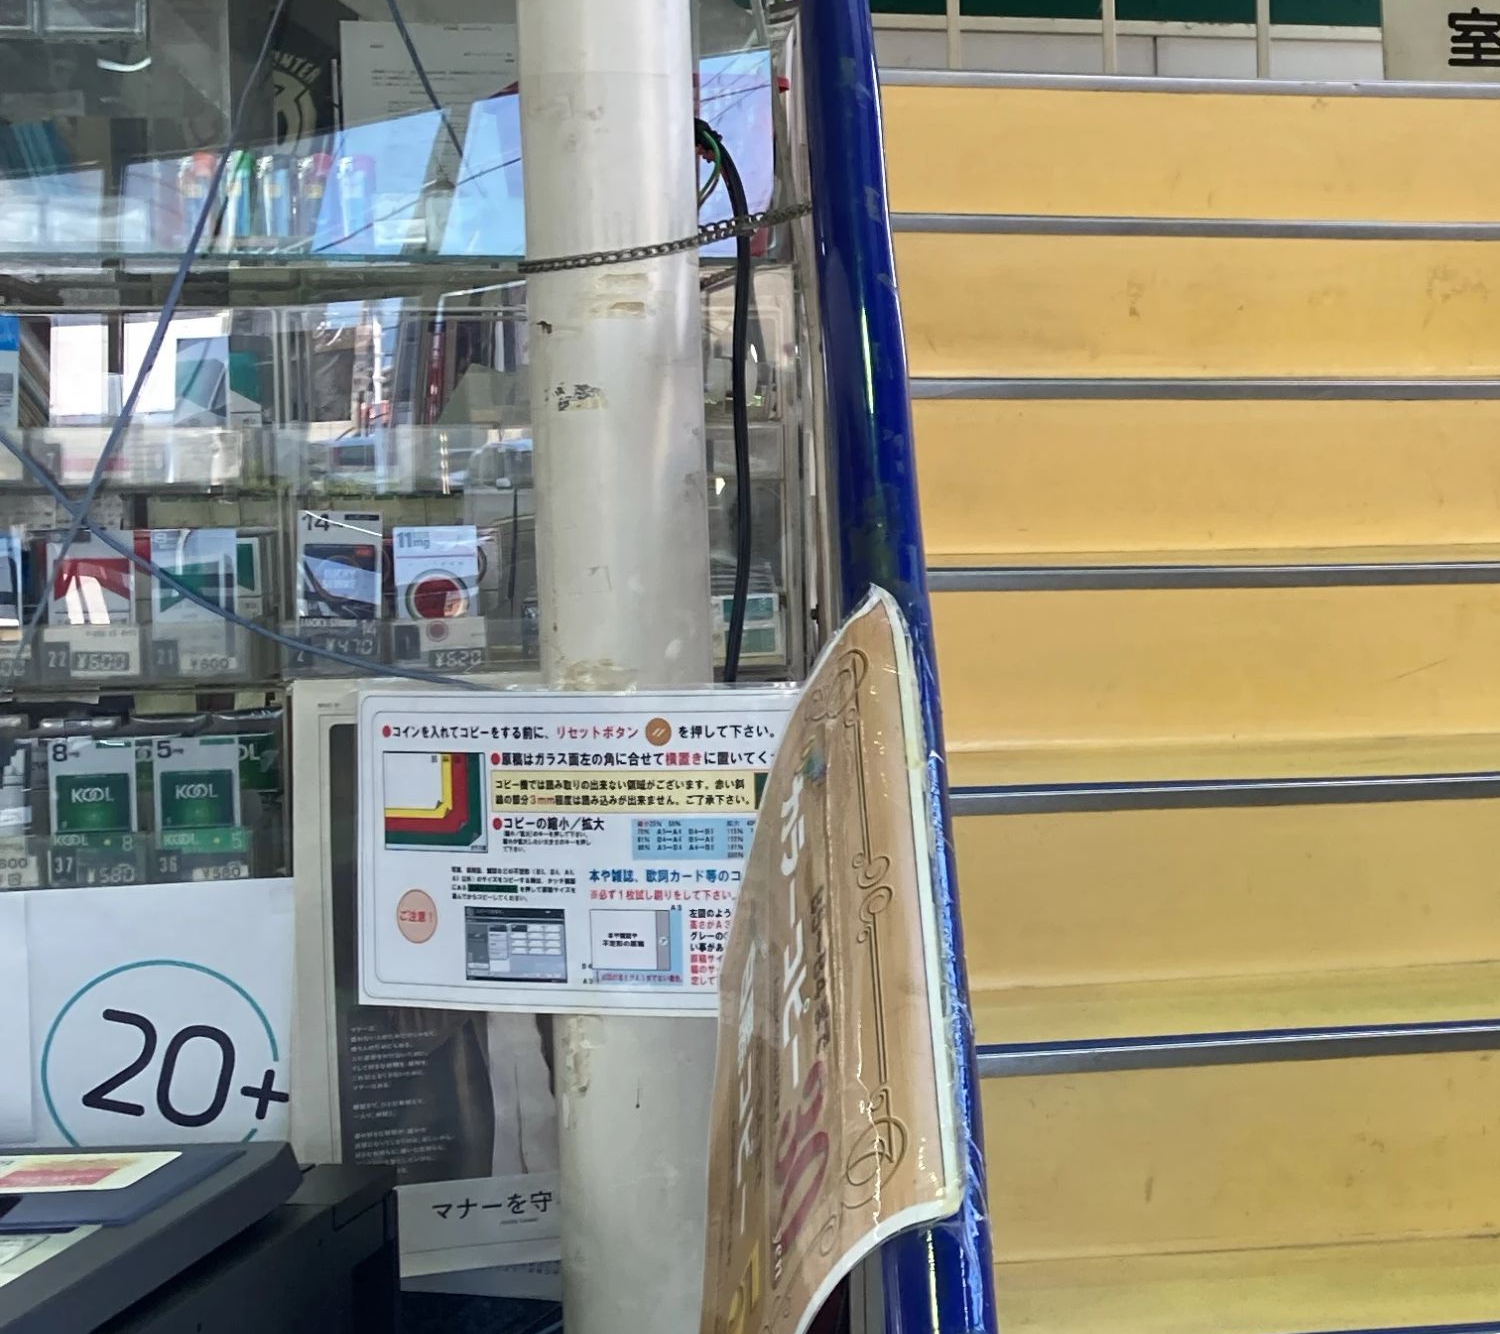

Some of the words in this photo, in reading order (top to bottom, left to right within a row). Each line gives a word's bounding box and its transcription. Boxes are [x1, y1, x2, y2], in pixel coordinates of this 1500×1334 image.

[678, 724, 775, 739] を押して下さい。
[501, 751, 774, 767] 原稿はガラス面左の角に合せて横置きに置いてく
[71, 786, 115, 803] KOOL
[175, 784, 219, 800] KOOL
[82, 1008, 290, 1128] 20+
